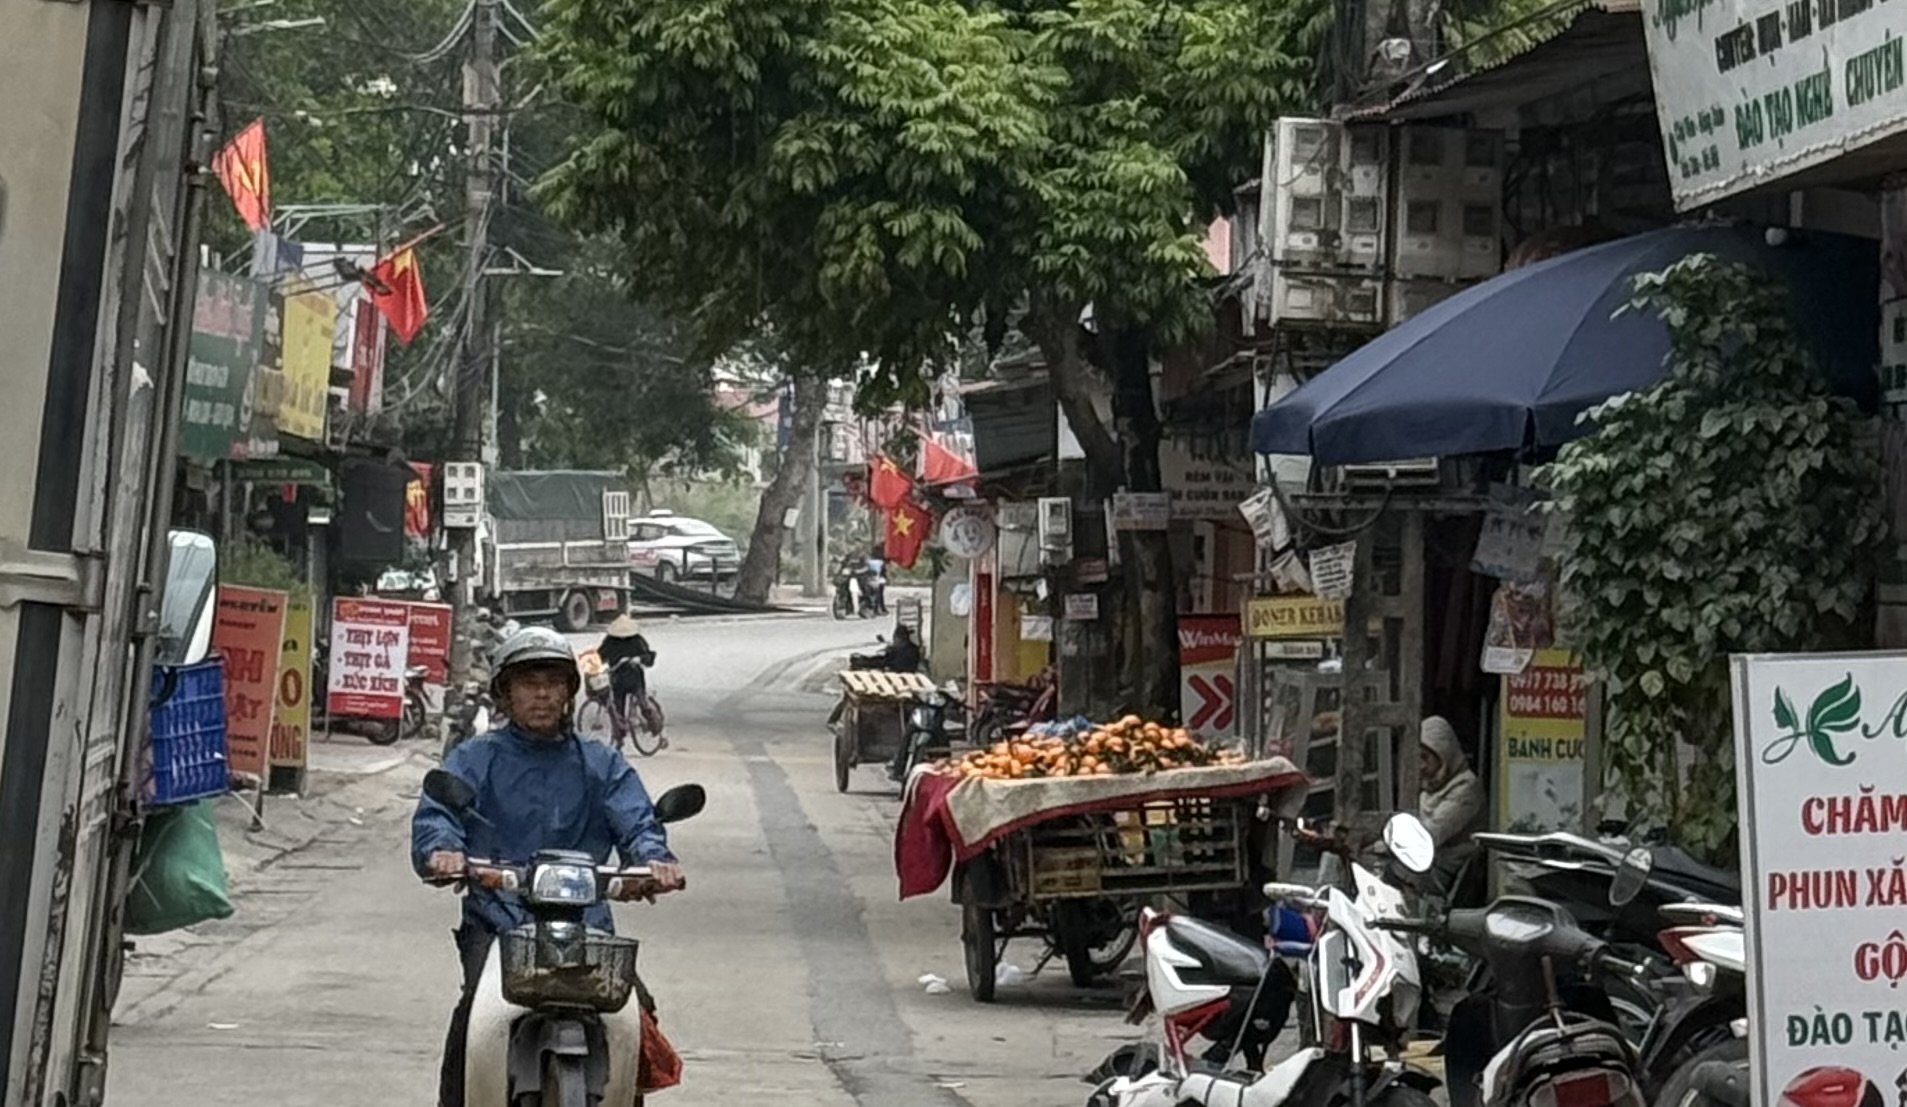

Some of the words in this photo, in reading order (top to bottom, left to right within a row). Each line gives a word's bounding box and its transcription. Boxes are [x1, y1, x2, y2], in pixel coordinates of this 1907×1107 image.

[1801, 783, 1907, 835] CHĂM
[1767, 870, 1857, 911] PHUN
[1865, 856, 1907, 907] XĂ
[1855, 929, 1907, 988] GỘ
[1787, 1004, 1853, 1047] ĐÀO
[1862, 1010, 1907, 1051] TẠ
